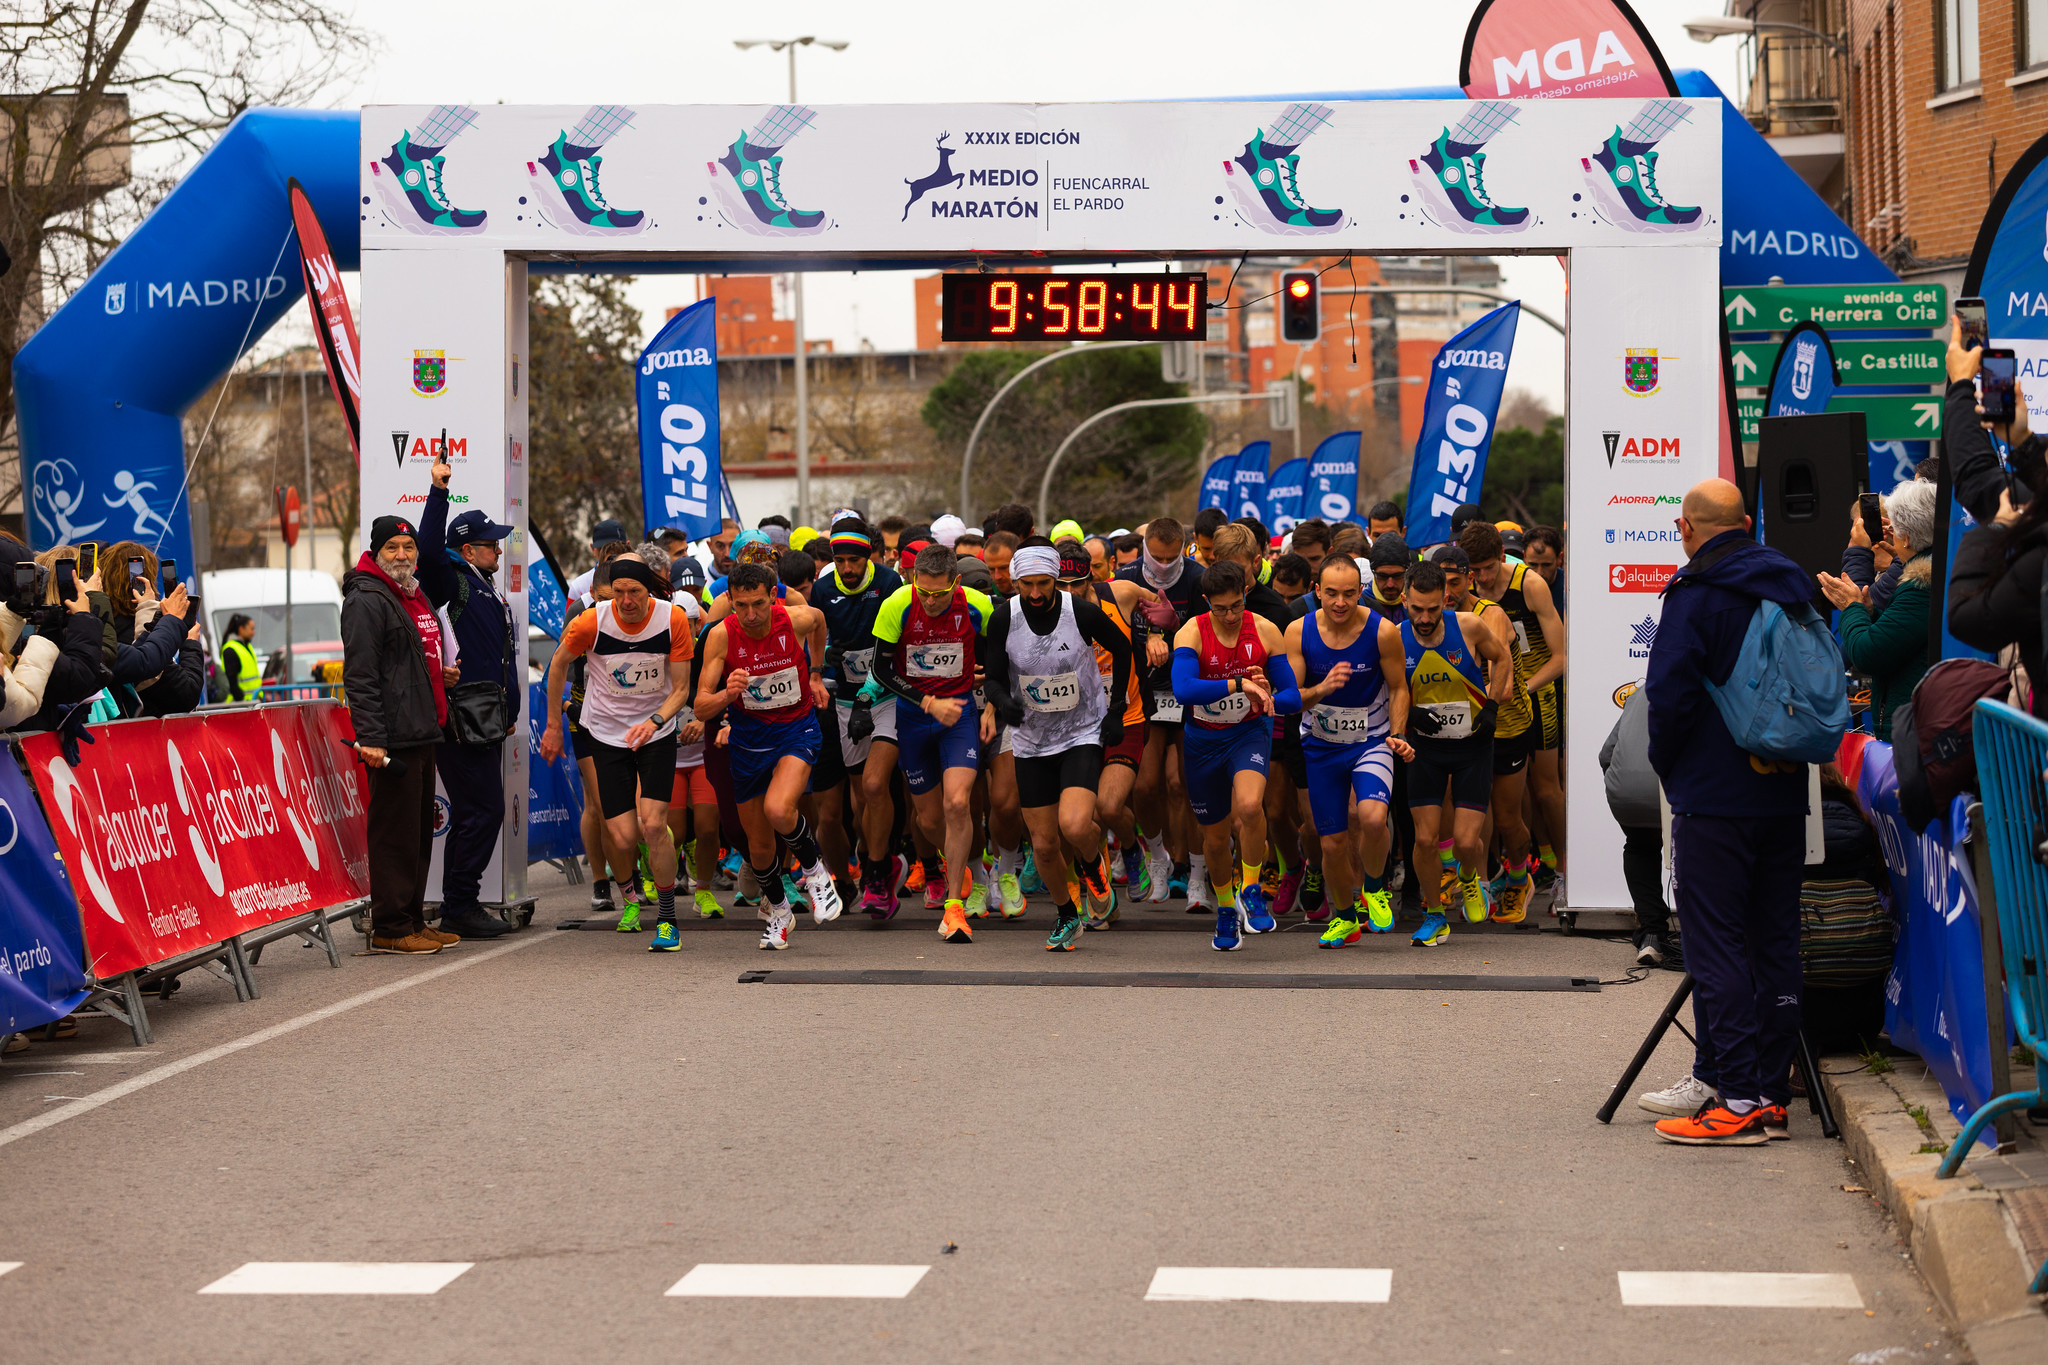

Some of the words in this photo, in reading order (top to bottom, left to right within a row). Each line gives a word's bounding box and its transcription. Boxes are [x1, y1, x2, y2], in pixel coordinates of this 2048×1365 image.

[964, 131, 1010, 145] XXXIX
[1015, 128, 1080, 145] EDICIÓN
[969, 169, 1039, 187] MEDIO
[1053, 177, 1150, 190] FUENCARRAL
[931, 196, 1038, 218] MARATÓN
[1053, 198, 1070, 210] EL
[1074, 198, 1124, 210] PARDO
[1730, 229, 1859, 260] MADRID
[148, 275, 287, 309] MADRID
[1843, 291, 1904, 304] avenida
[1913, 290, 1938, 303] del
[990, 281, 1196, 333] 9:58:44
[1779, 307, 1798, 323] C.
[1810, 306, 1883, 322] Herrera
[1896, 304, 1937, 321] Oria
[1861, 353, 1939, 370] Castilla
[410, 437, 467, 457] ADM
[1621, 437, 1680, 457] ADM
[1624, 530, 1682, 542] MADRID
[1627, 567, 1674, 587] alquiber
[753, 657, 792, 671] MARATHON
[933, 654, 958, 666] 697
[634, 668, 659, 682] 713
[1420, 671, 1452, 685] UCA
[769, 680, 793, 695] 001
[1044, 683, 1076, 699] 1421
[1218, 697, 1244, 711] 015
[1333, 719, 1366, 731] 1234
[93, 762, 178, 911] alquiber
[147, 907, 181, 939] Renting
[172, 900, 201, 932] Flexible
[14, 938, 52, 982] pardo
